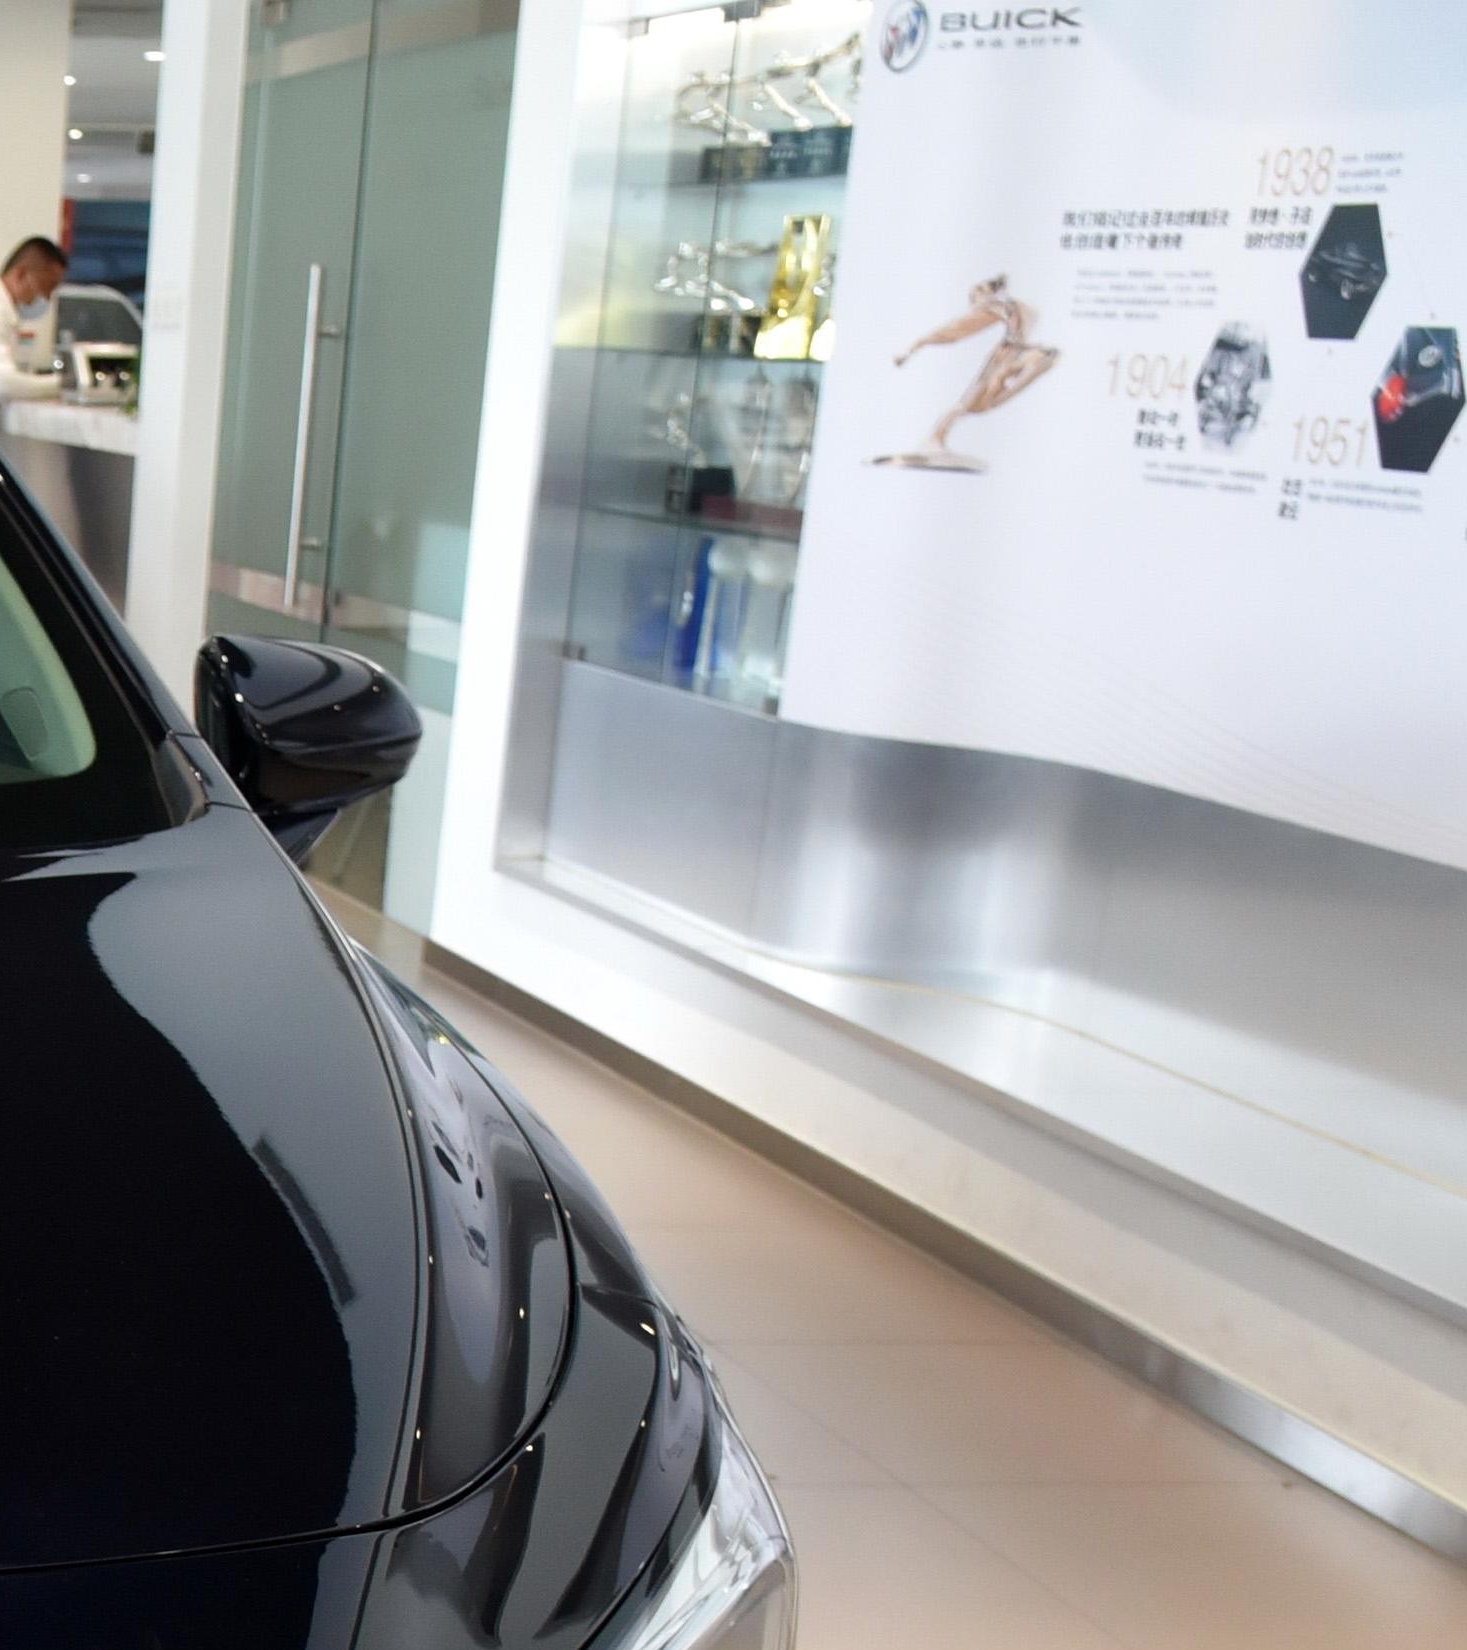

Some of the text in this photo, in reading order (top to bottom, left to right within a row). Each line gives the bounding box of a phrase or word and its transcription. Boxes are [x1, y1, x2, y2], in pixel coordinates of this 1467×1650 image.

[939, 8, 1081, 31] BUICK
[1257, 147, 1334, 196] 1938
[1106, 353, 1189, 398] 1904
[1291, 414, 1370, 467] 1951
